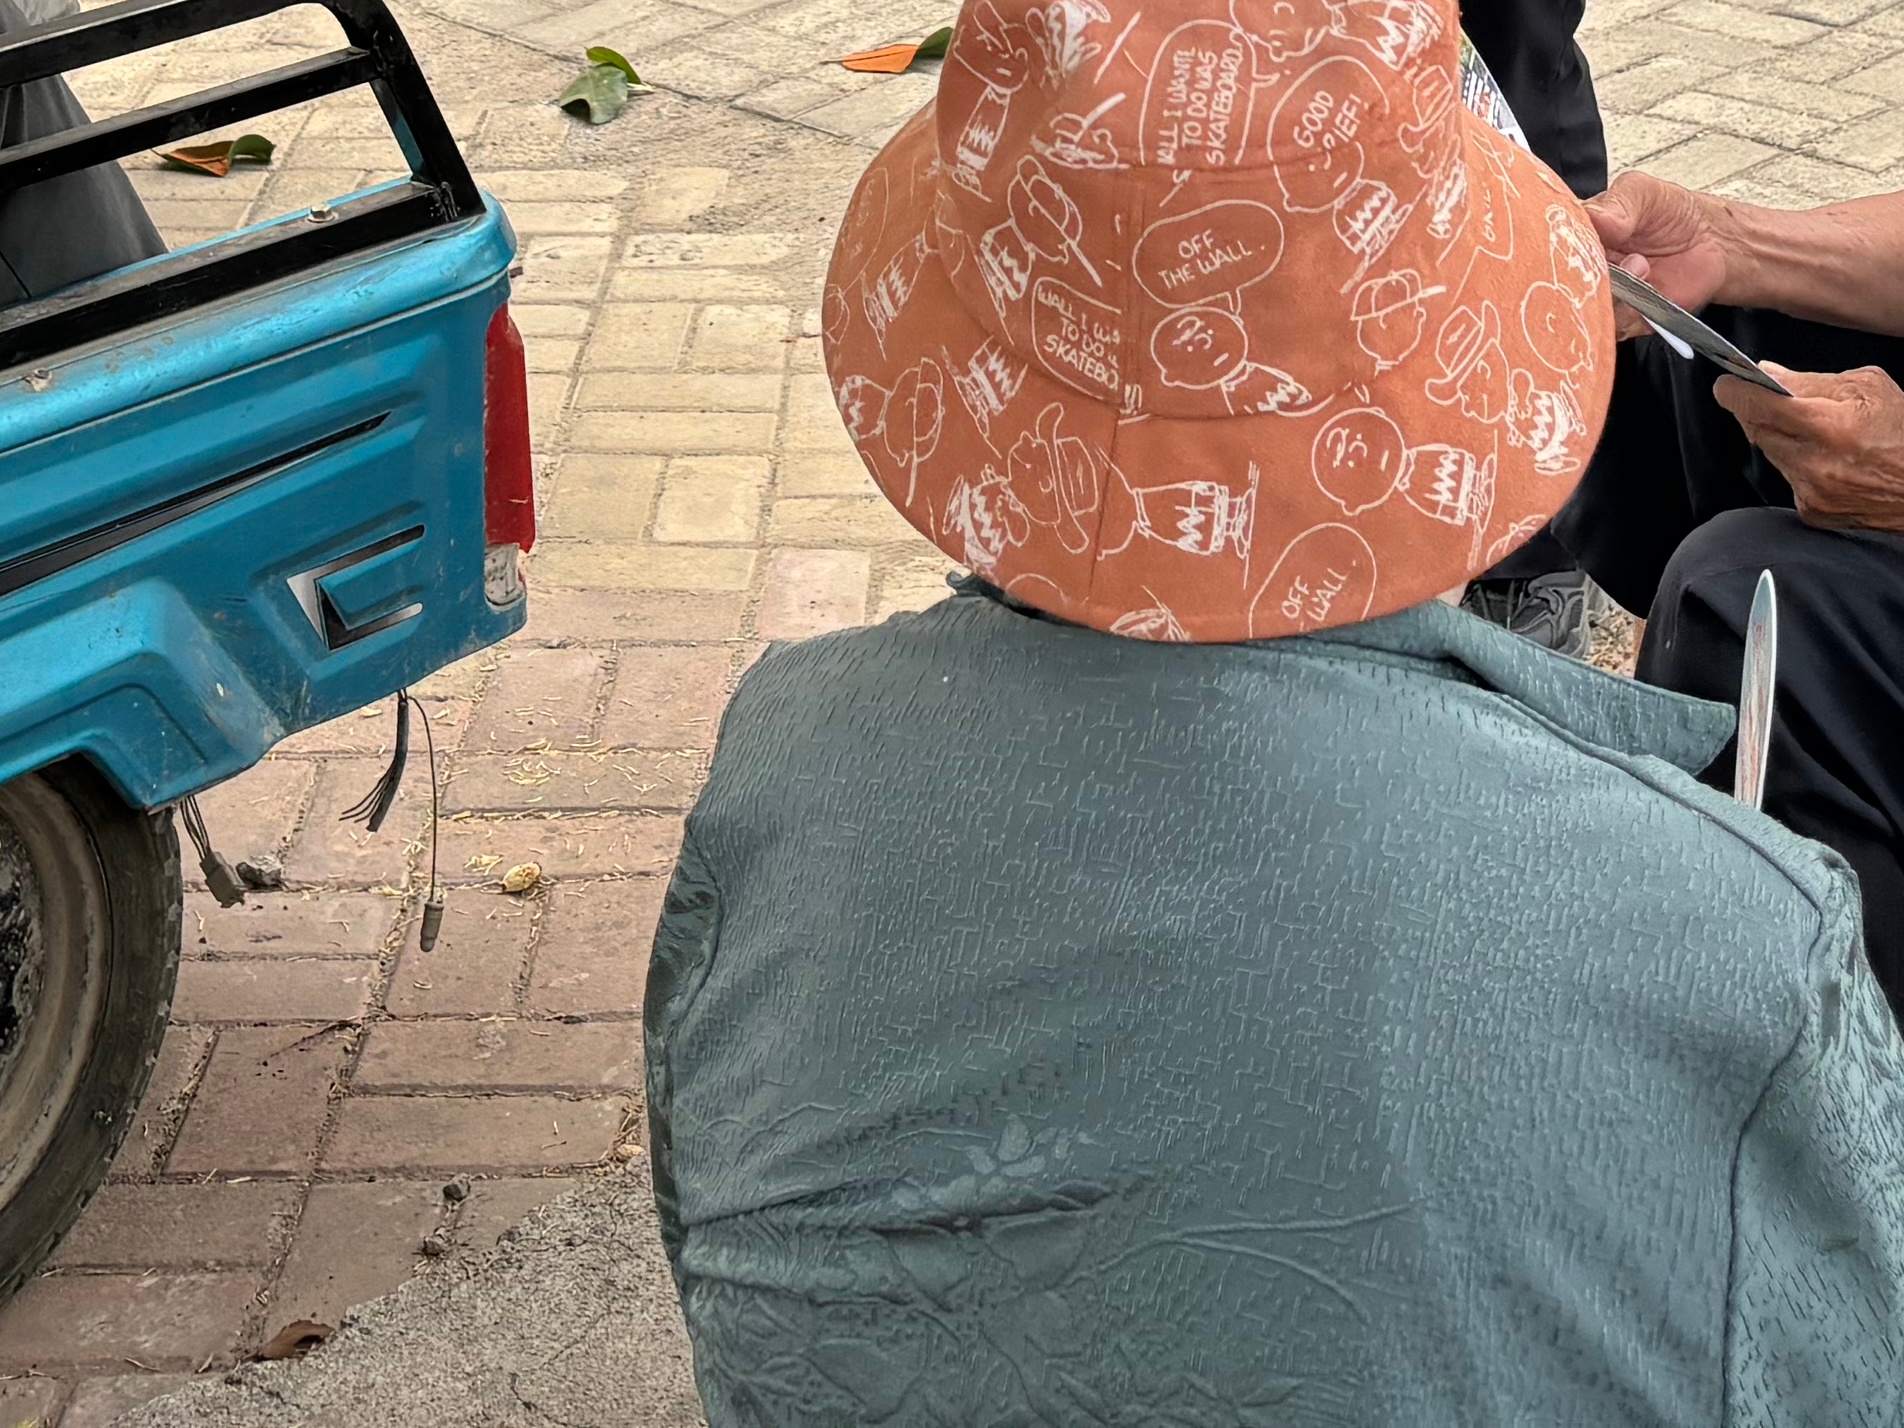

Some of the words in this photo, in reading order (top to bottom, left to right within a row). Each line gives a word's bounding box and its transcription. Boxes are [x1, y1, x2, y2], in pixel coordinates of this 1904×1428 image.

[1186, 90, 1209, 119] DO
[1292, 90, 1336, 149] GOOD
[1182, 120, 1203, 148] TO
[1178, 229, 1216, 259] OFF
[1157, 263, 1197, 291] THE
[1037, 285, 1077, 322] WALL
[1059, 316, 1080, 343] TO
[1081, 334, 1105, 358] DO
[1280, 574, 1311, 620] OFF
